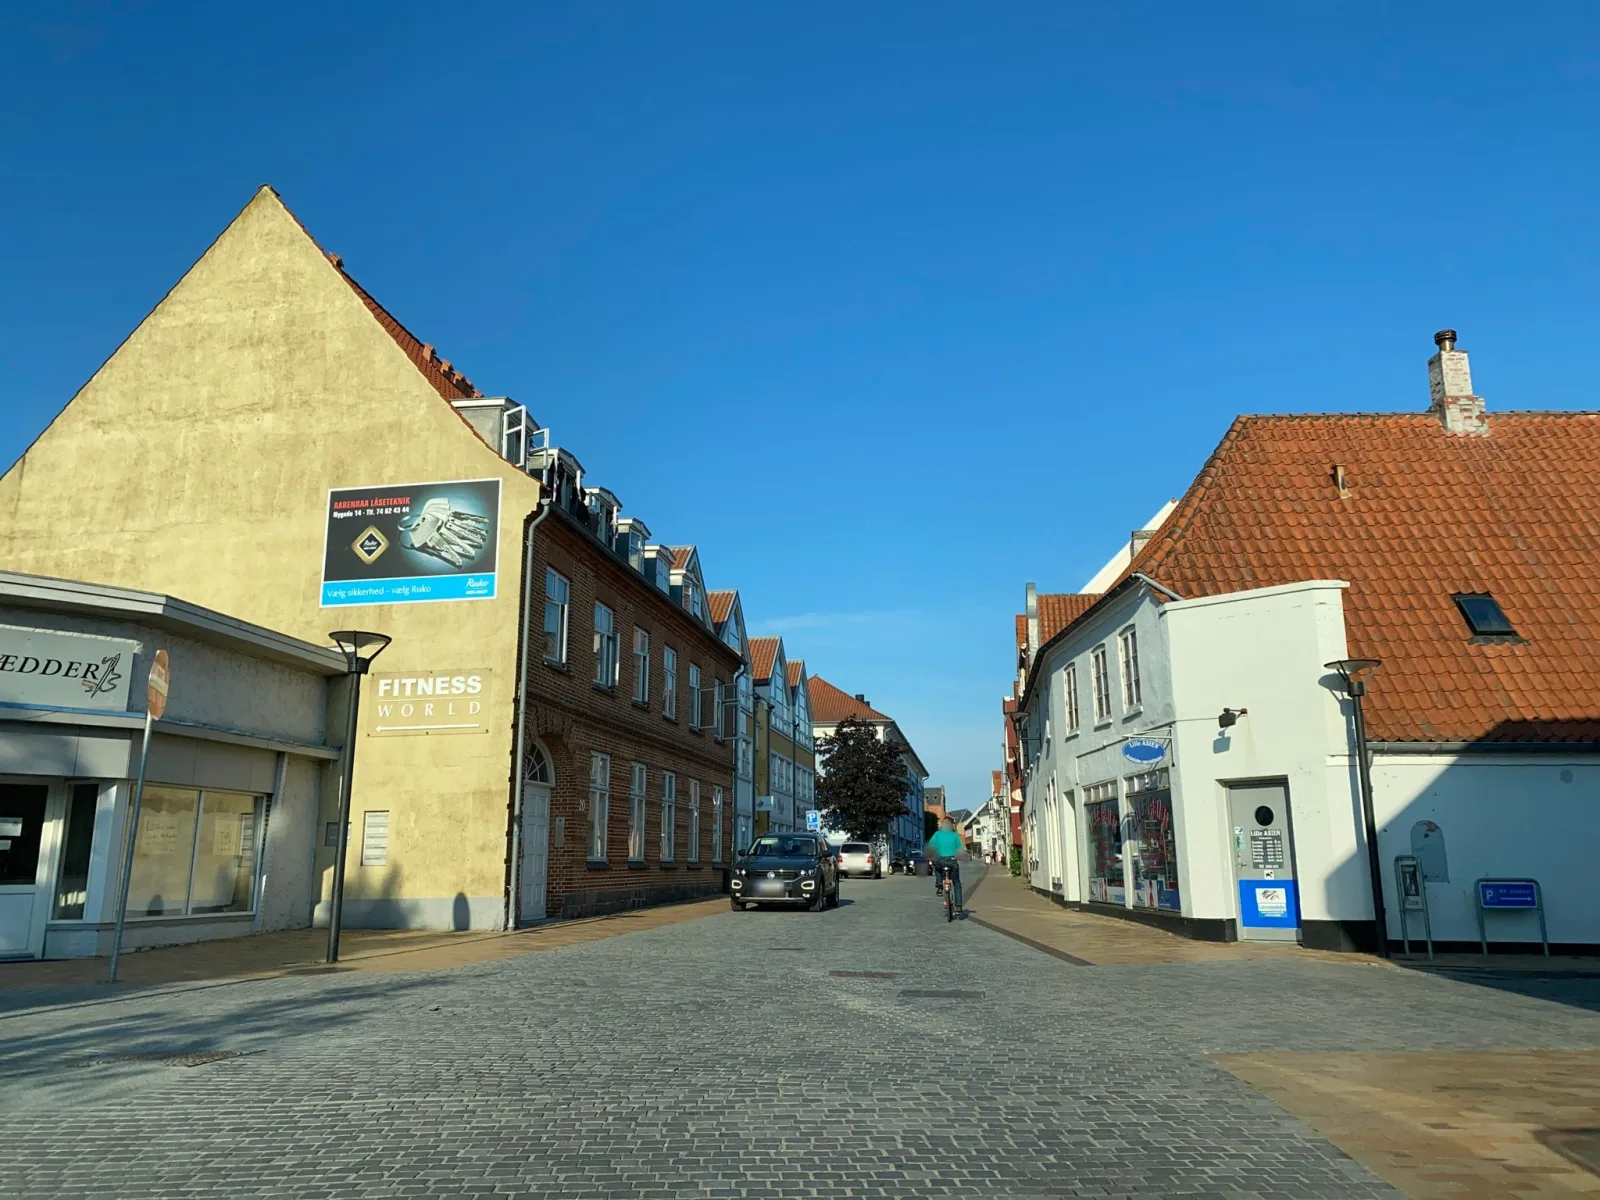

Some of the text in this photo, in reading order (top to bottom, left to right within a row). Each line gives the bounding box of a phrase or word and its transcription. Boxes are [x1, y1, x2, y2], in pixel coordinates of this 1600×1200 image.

[333, 497, 410, 509] AABENRAA LÅSETEKNIK
[466, 578, 489, 587] Ruko
[327, 589, 346, 598] Vælg
[347, 586, 384, 596] sikkerhed
[391, 585, 409, 595] vælg
[411, 584, 431, 593] Ruko
[378, 675, 482, 697] FITNESS
[378, 701, 480, 718] WORLD
[579, 799, 586, 811] 20
[1486, 890, 1494, 900] P
